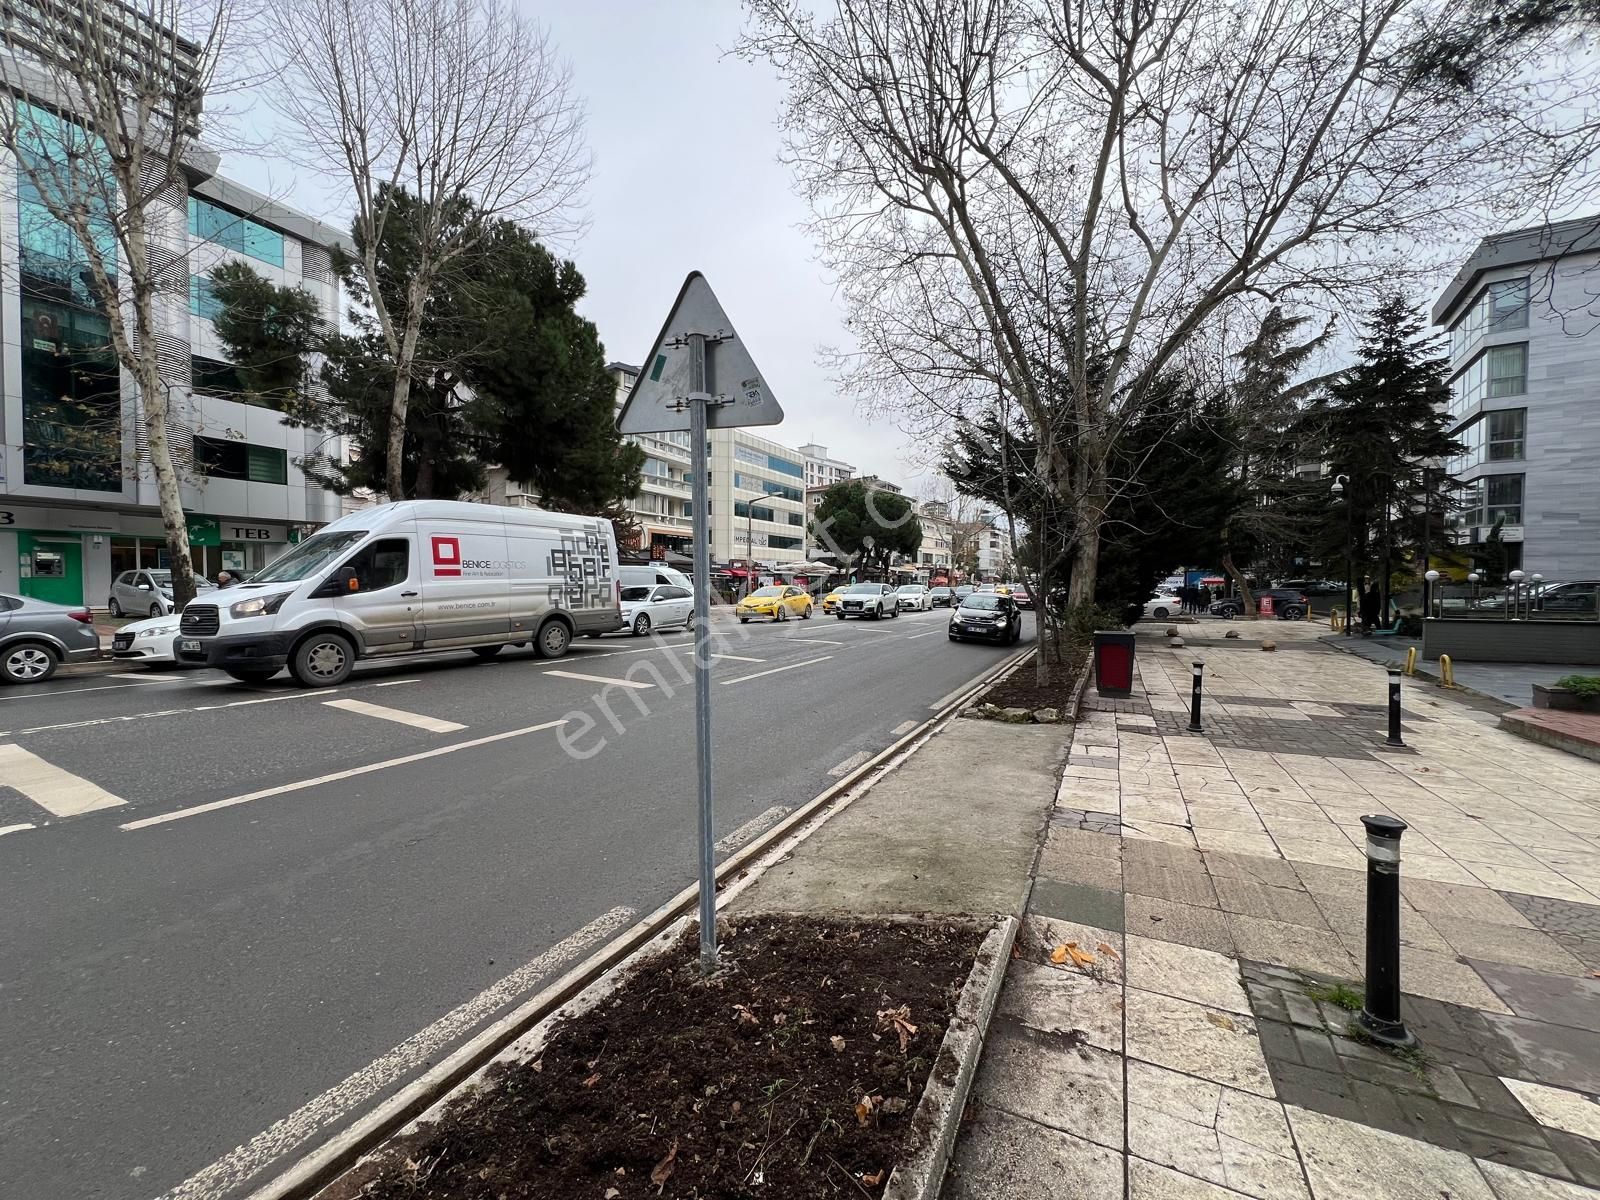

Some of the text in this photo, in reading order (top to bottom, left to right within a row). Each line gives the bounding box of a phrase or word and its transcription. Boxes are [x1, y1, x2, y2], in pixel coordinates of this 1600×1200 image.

[232, 527, 271, 540] TEB
[733, 536, 758, 545] IMPEAL
[462, 560, 491, 568] BENICE
